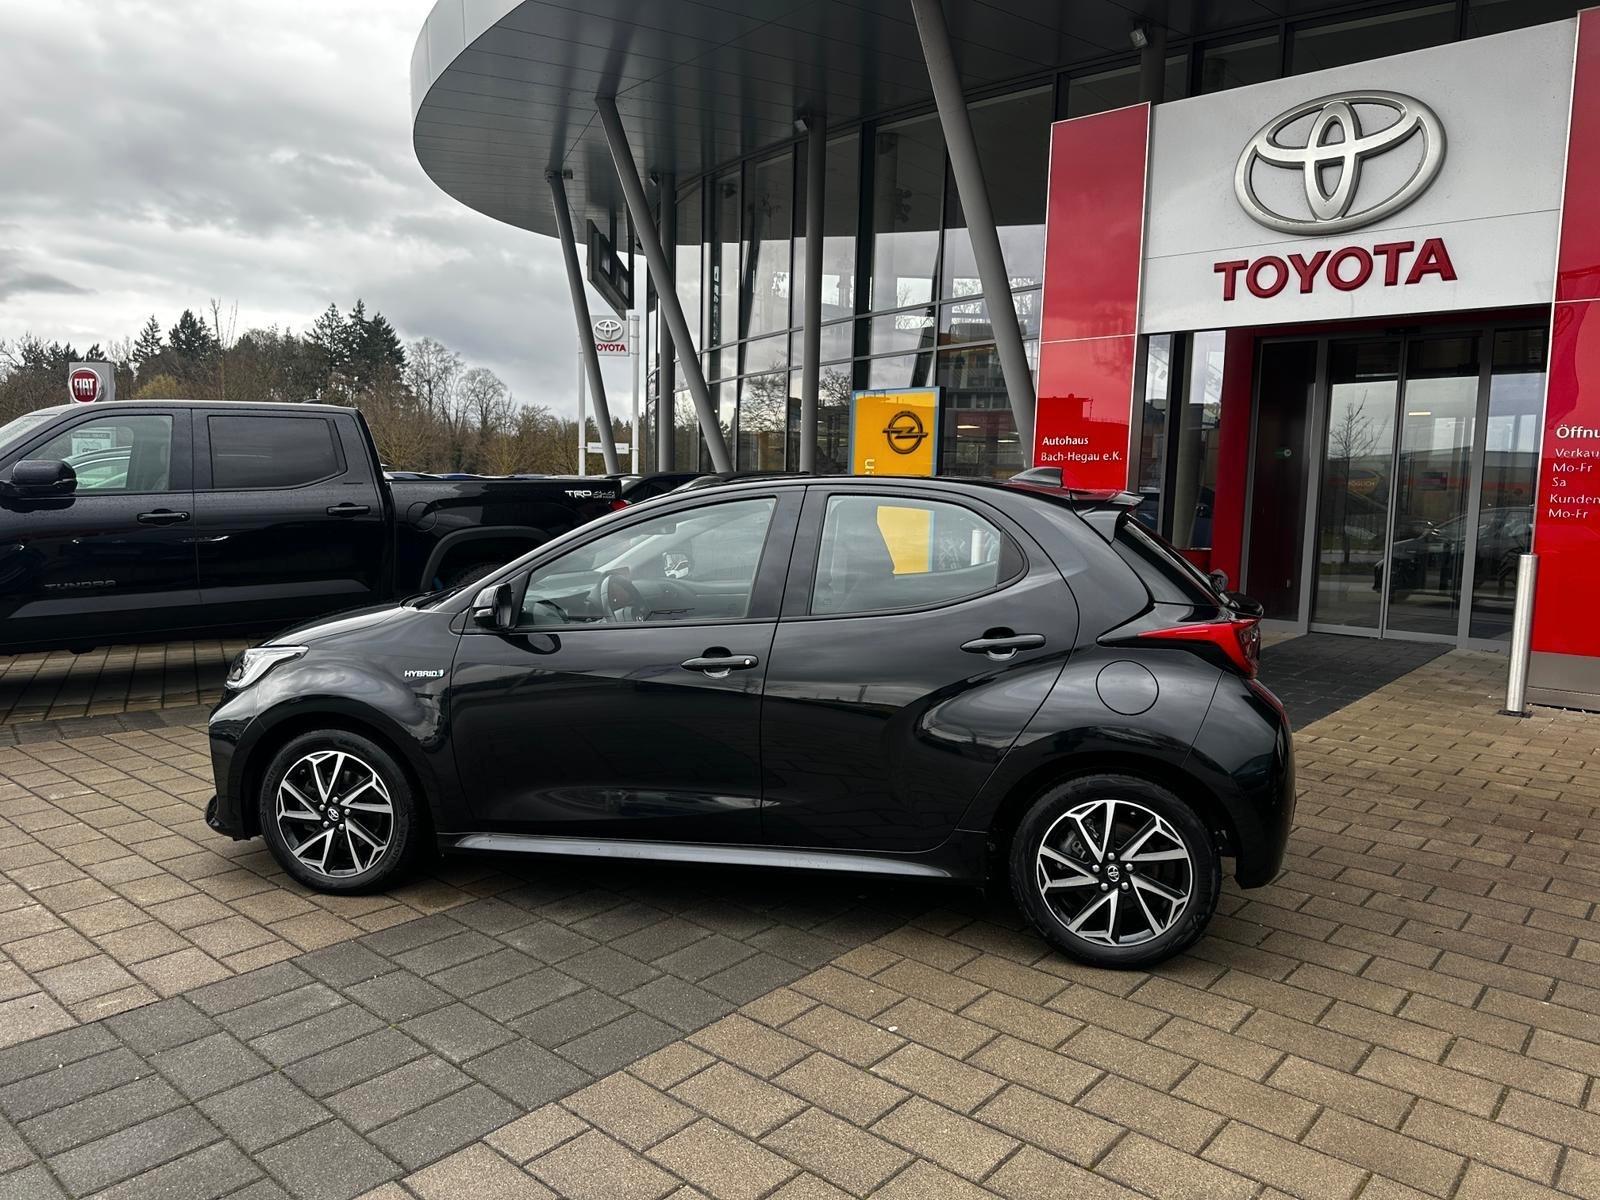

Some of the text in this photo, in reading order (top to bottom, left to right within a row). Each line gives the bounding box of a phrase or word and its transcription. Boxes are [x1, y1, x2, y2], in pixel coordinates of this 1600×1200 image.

[1214, 238, 1458, 301] TOYOTA
[595, 343, 627, 352] OYOTA
[74, 378, 95, 396] FIAT
[1042, 436, 1088, 446] Autohaus
[1041, 451, 1122, 463] Bach-Hegau e.K.
[1552, 462, 1593, 473] Mo-Fr
[1552, 477, 1567, 487] Sa
[1549, 508, 1589, 518] Mo-Fr
